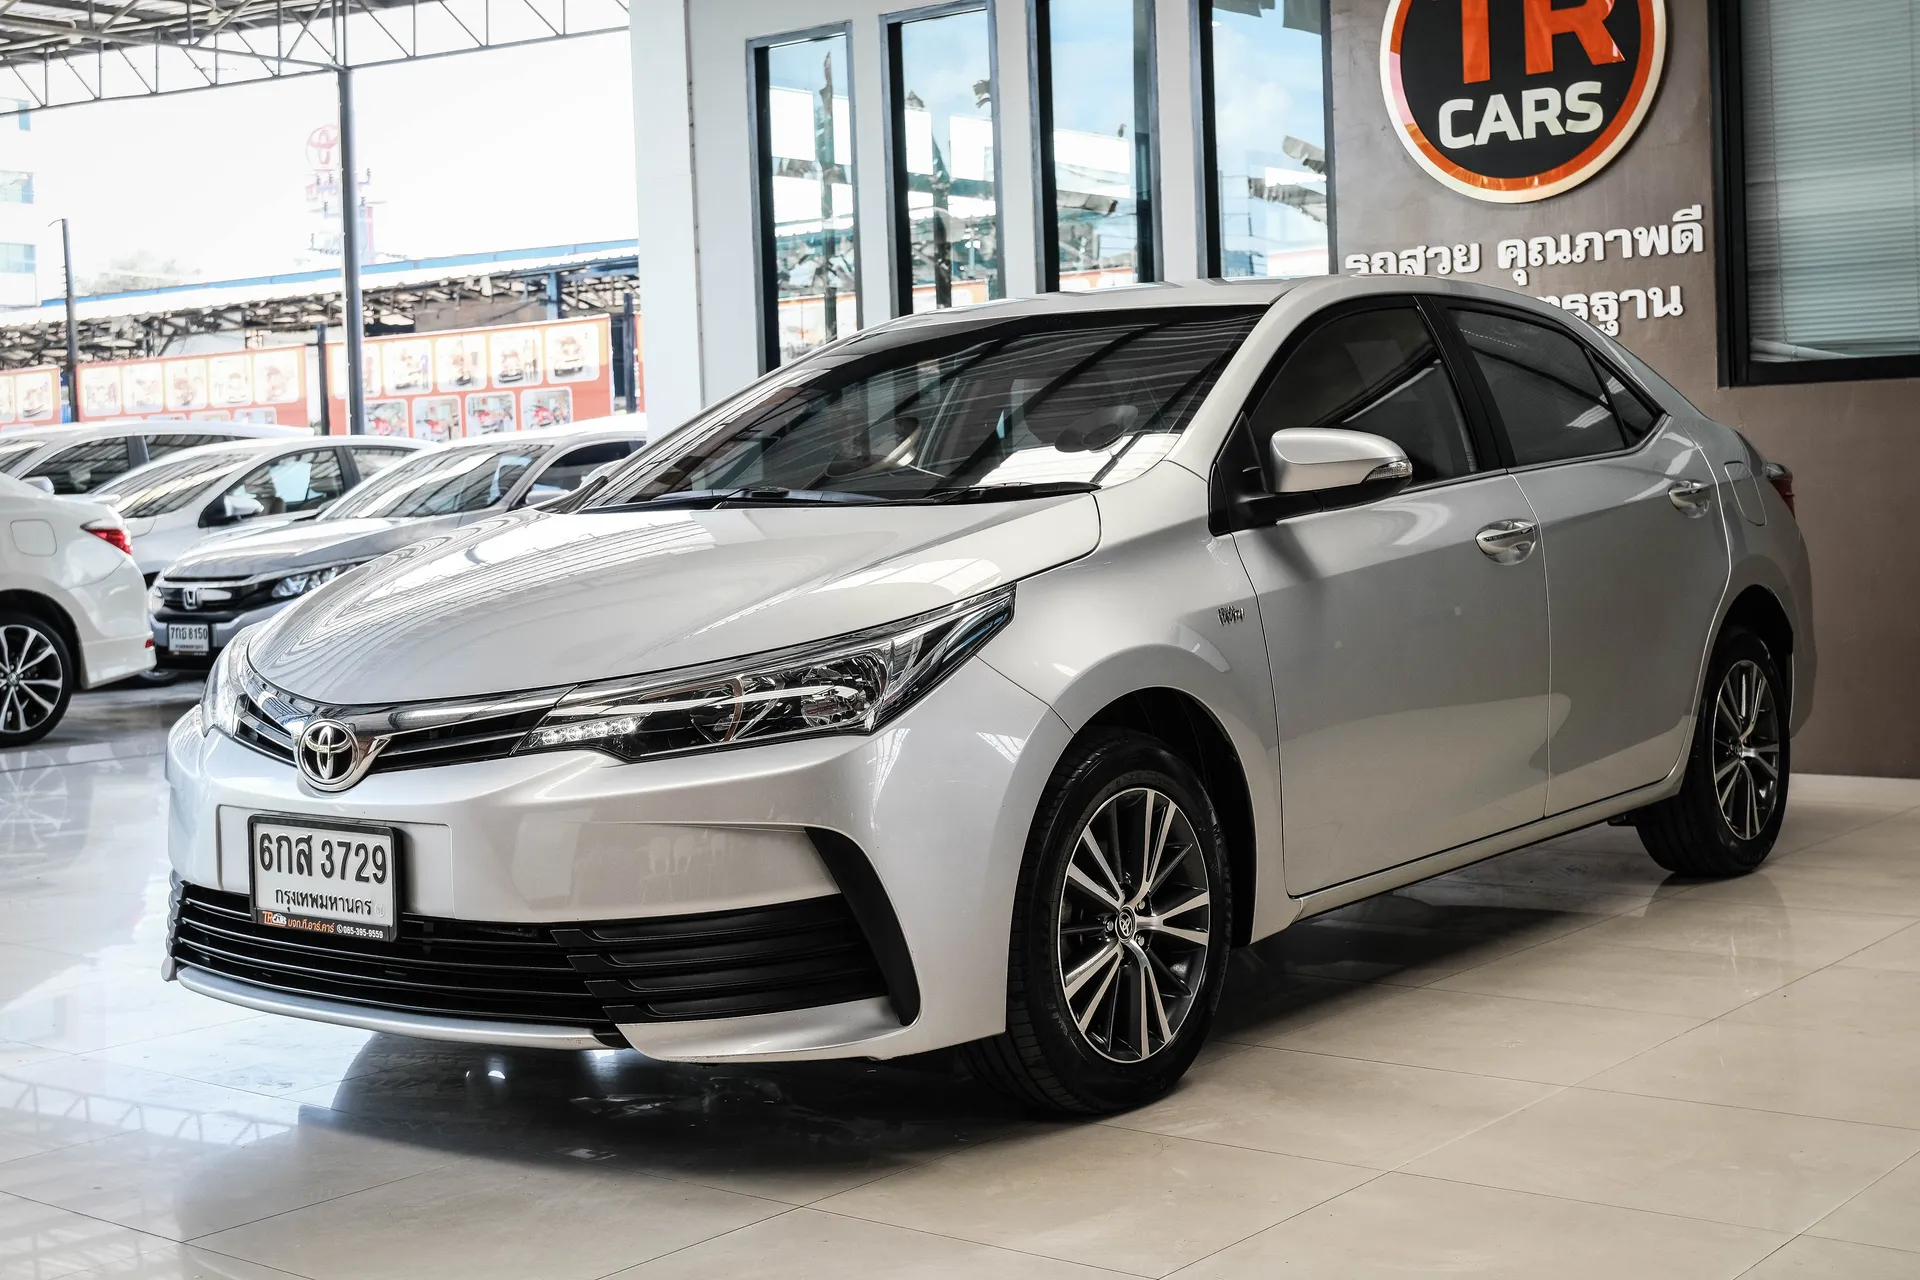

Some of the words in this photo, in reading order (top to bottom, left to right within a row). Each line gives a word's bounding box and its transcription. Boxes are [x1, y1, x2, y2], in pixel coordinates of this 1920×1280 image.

[1438, 81, 1604, 149] CARS
[1497, 204, 1704, 286] คุณภาพดี
[188, 627, 208, 640] 8150
[259, 832, 313, 877] 6กส
[320, 838, 387, 884] 3729
[275, 888, 372, 916] กรุงเทพมหานคร
